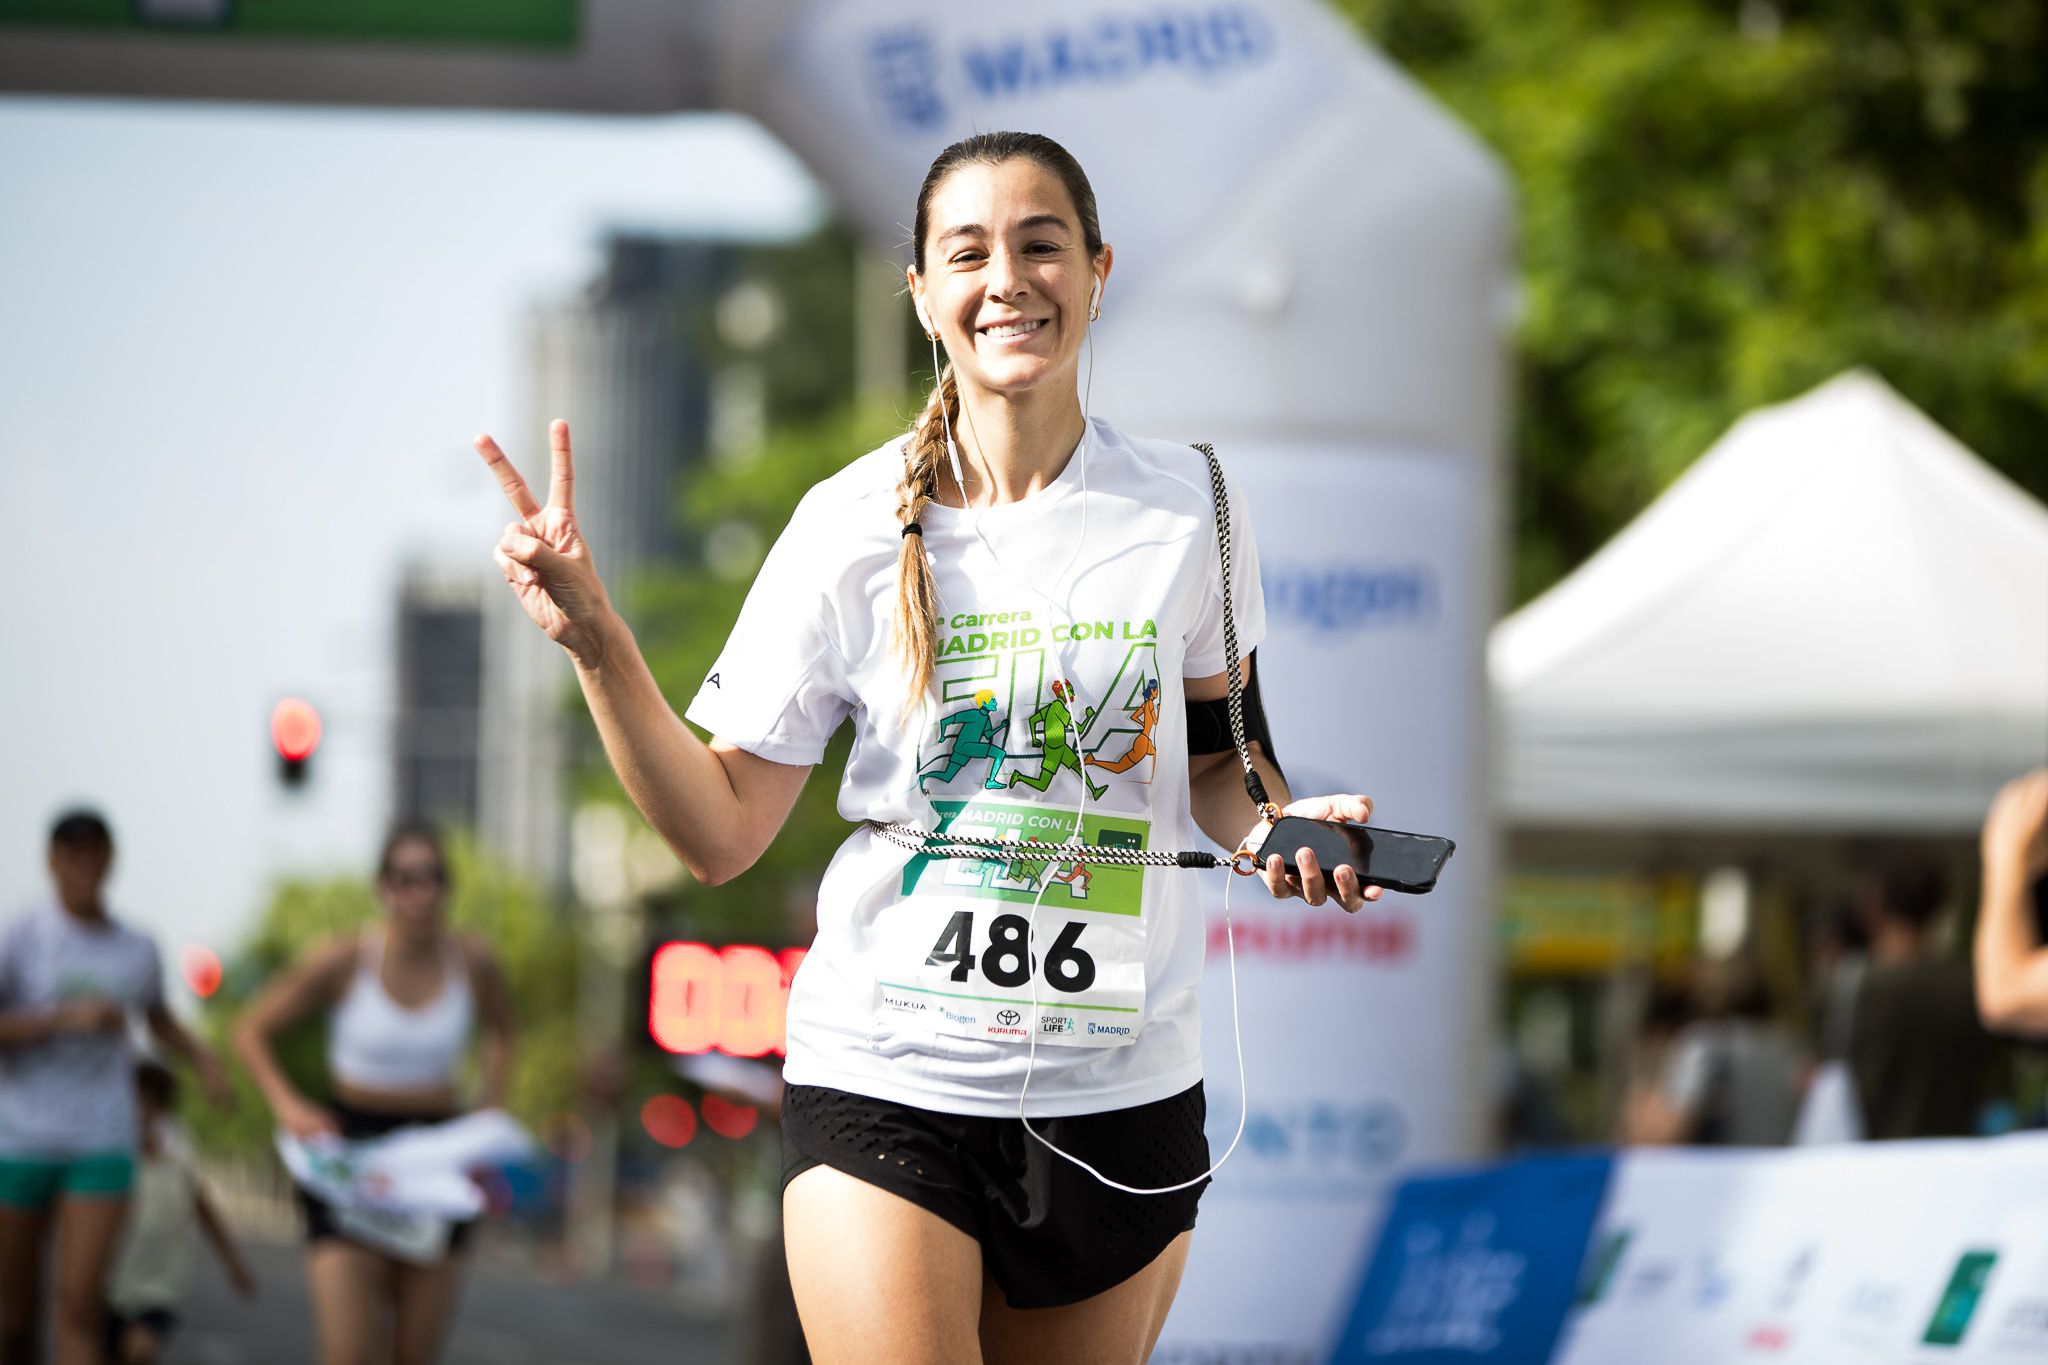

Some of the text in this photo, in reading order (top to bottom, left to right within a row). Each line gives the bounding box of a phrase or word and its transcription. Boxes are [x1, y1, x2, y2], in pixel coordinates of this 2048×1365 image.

[950, 610, 1032, 629] Carrera
[1052, 621, 1114, 642] CON
[1123, 619, 1157, 640] LA
[961, 809, 1024, 826] MADRID
[1028, 815, 1062, 830] CON
[1066, 820, 1085, 833] LA
[925, 910, 1096, 993] 486
[885, 998, 927, 1011] MUKUA
[945, 1011, 976, 1024] Biogen
[1041, 1016, 1067, 1025] SPORT
[1043, 1024, 1063, 1033] LIFE
[1097, 1025, 1130, 1036] MADRID
